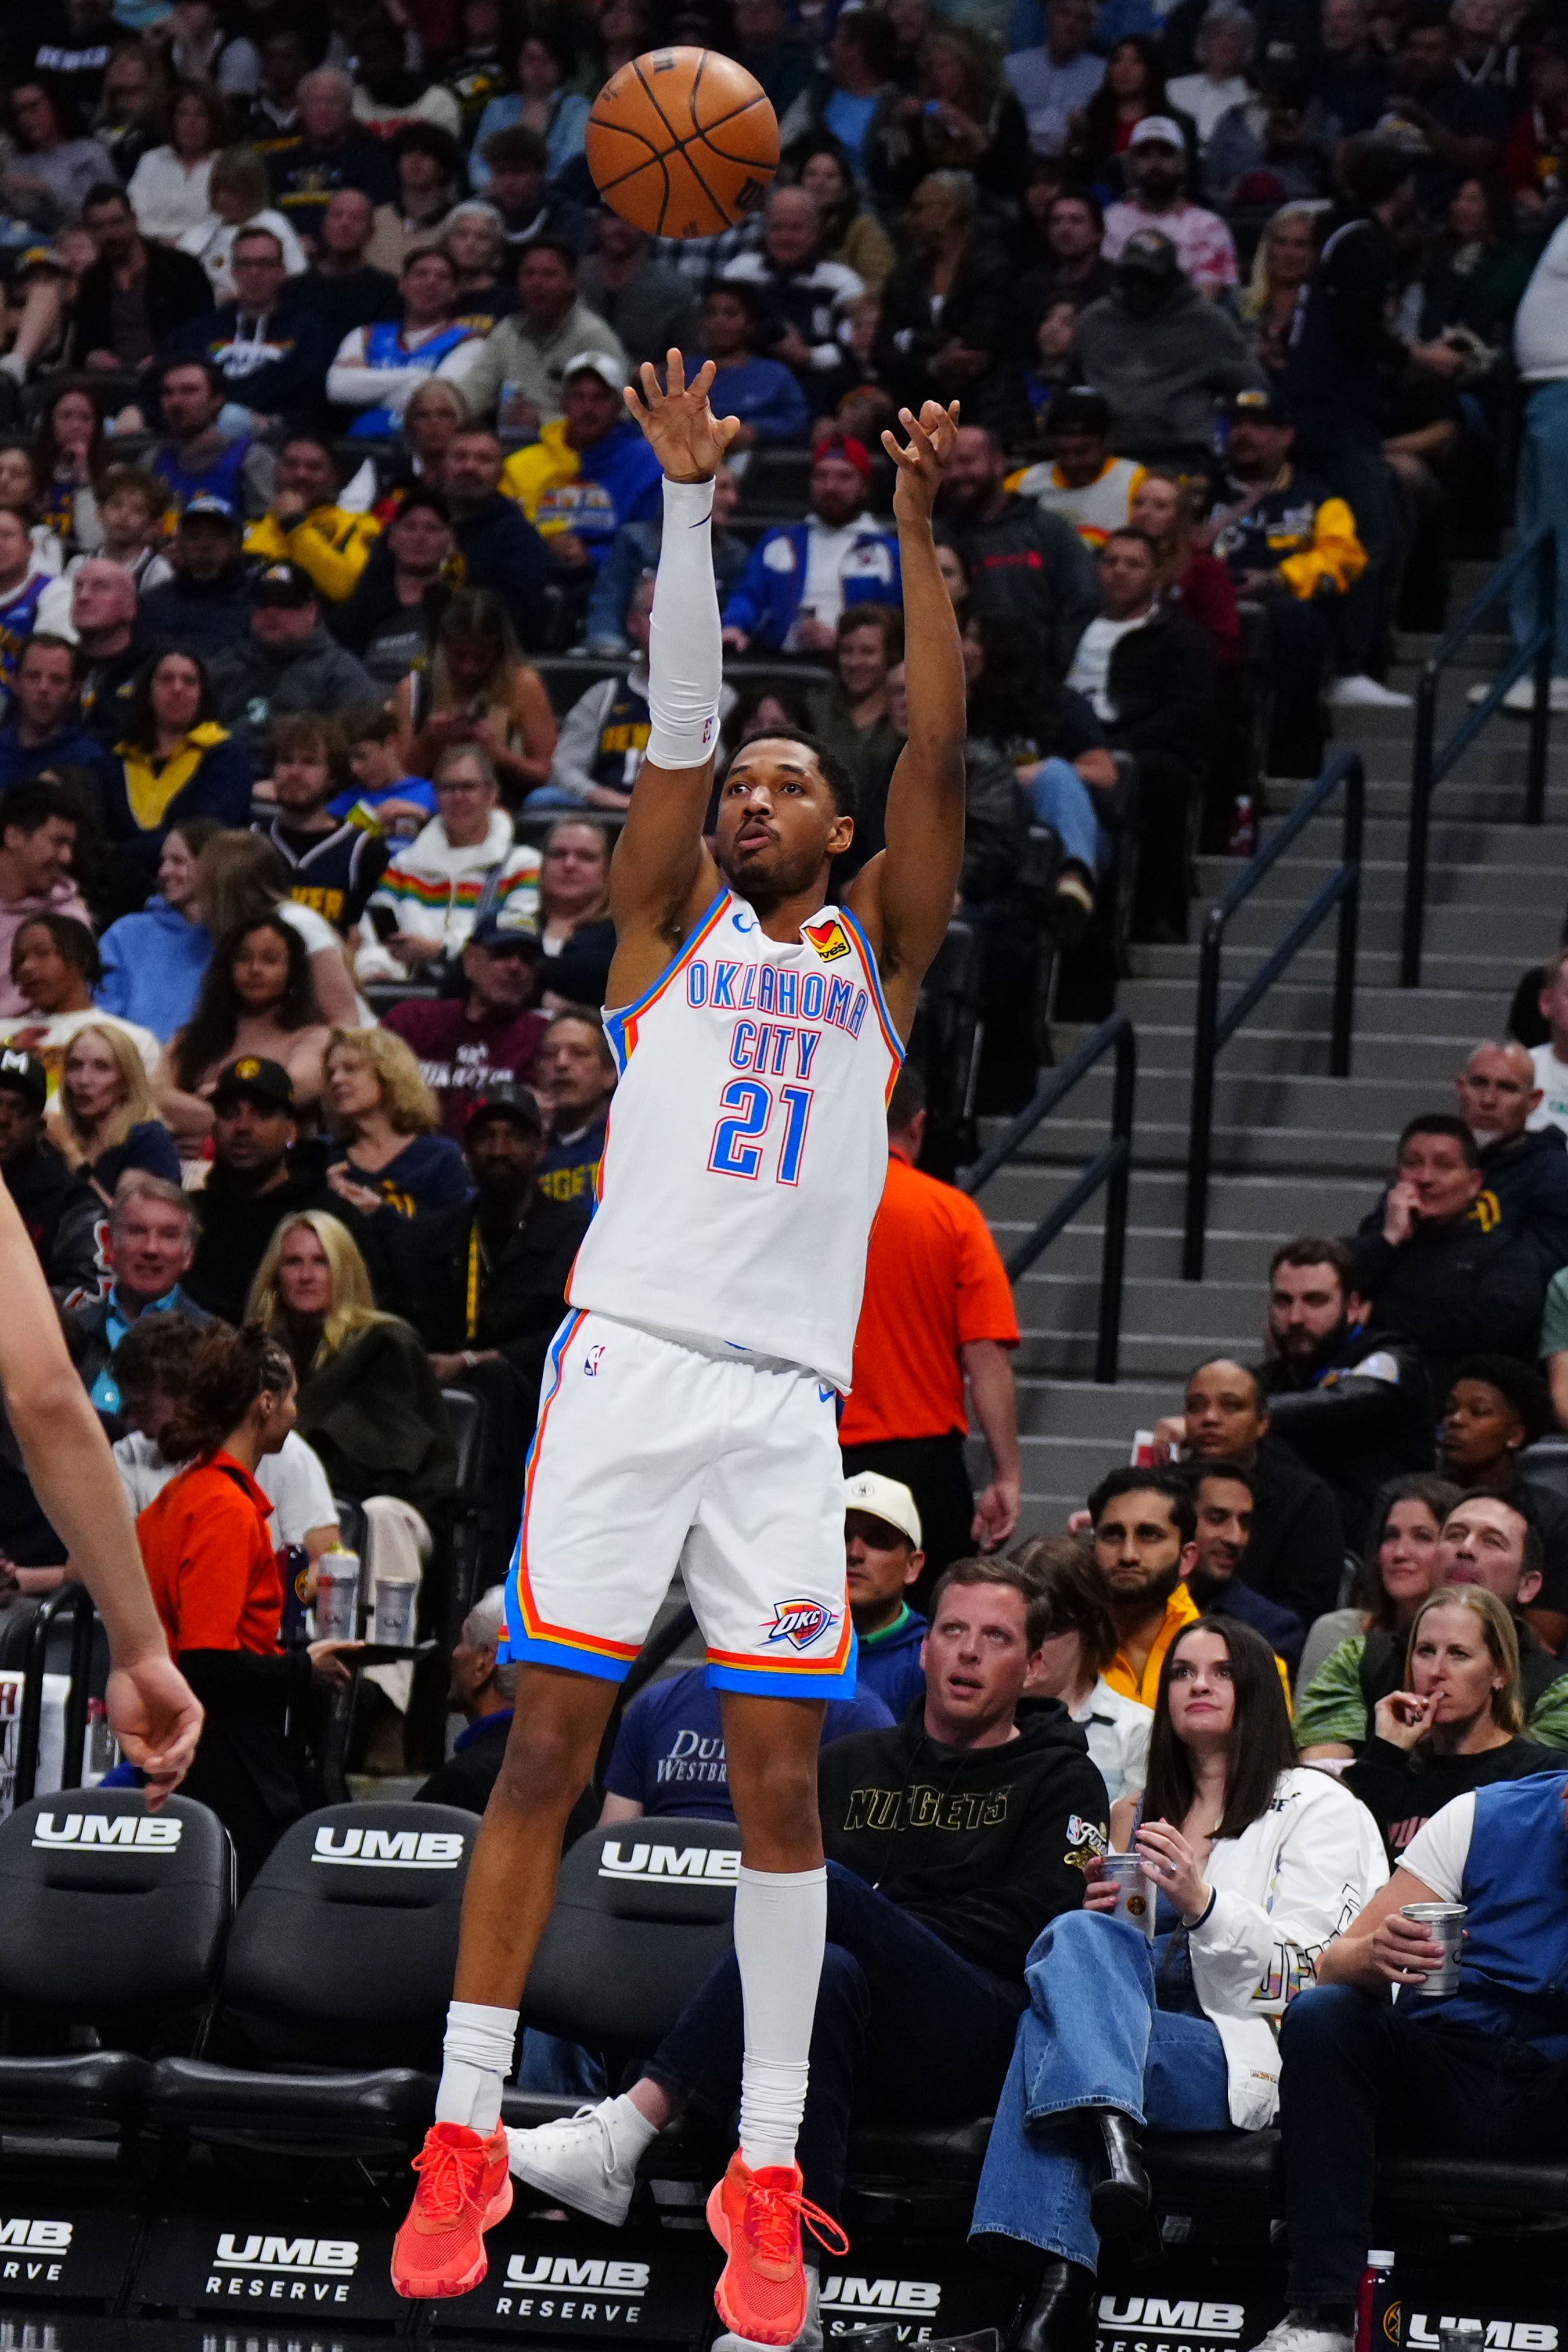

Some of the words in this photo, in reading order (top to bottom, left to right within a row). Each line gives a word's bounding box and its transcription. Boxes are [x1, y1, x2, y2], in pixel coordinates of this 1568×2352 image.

[686, 959, 869, 1041] OKLAHOMA
[729, 1019, 822, 1080] CITY
[707, 1077, 814, 1187] 21
[769, 1610, 820, 1638] OKC
[34, 1812, 183, 1846] UMB
[315, 1827, 464, 1861] UMB
[600, 1840, 740, 1878] UMB
[216, 2234, 359, 2267] UMB
[507, 2254, 650, 2288] UMB
[206, 2277, 349, 2302] RESERVE
[496, 2297, 640, 2322] RESERVE
[1098, 2296, 1245, 2330] UMB
[1409, 2314, 1559, 2351] UMB
